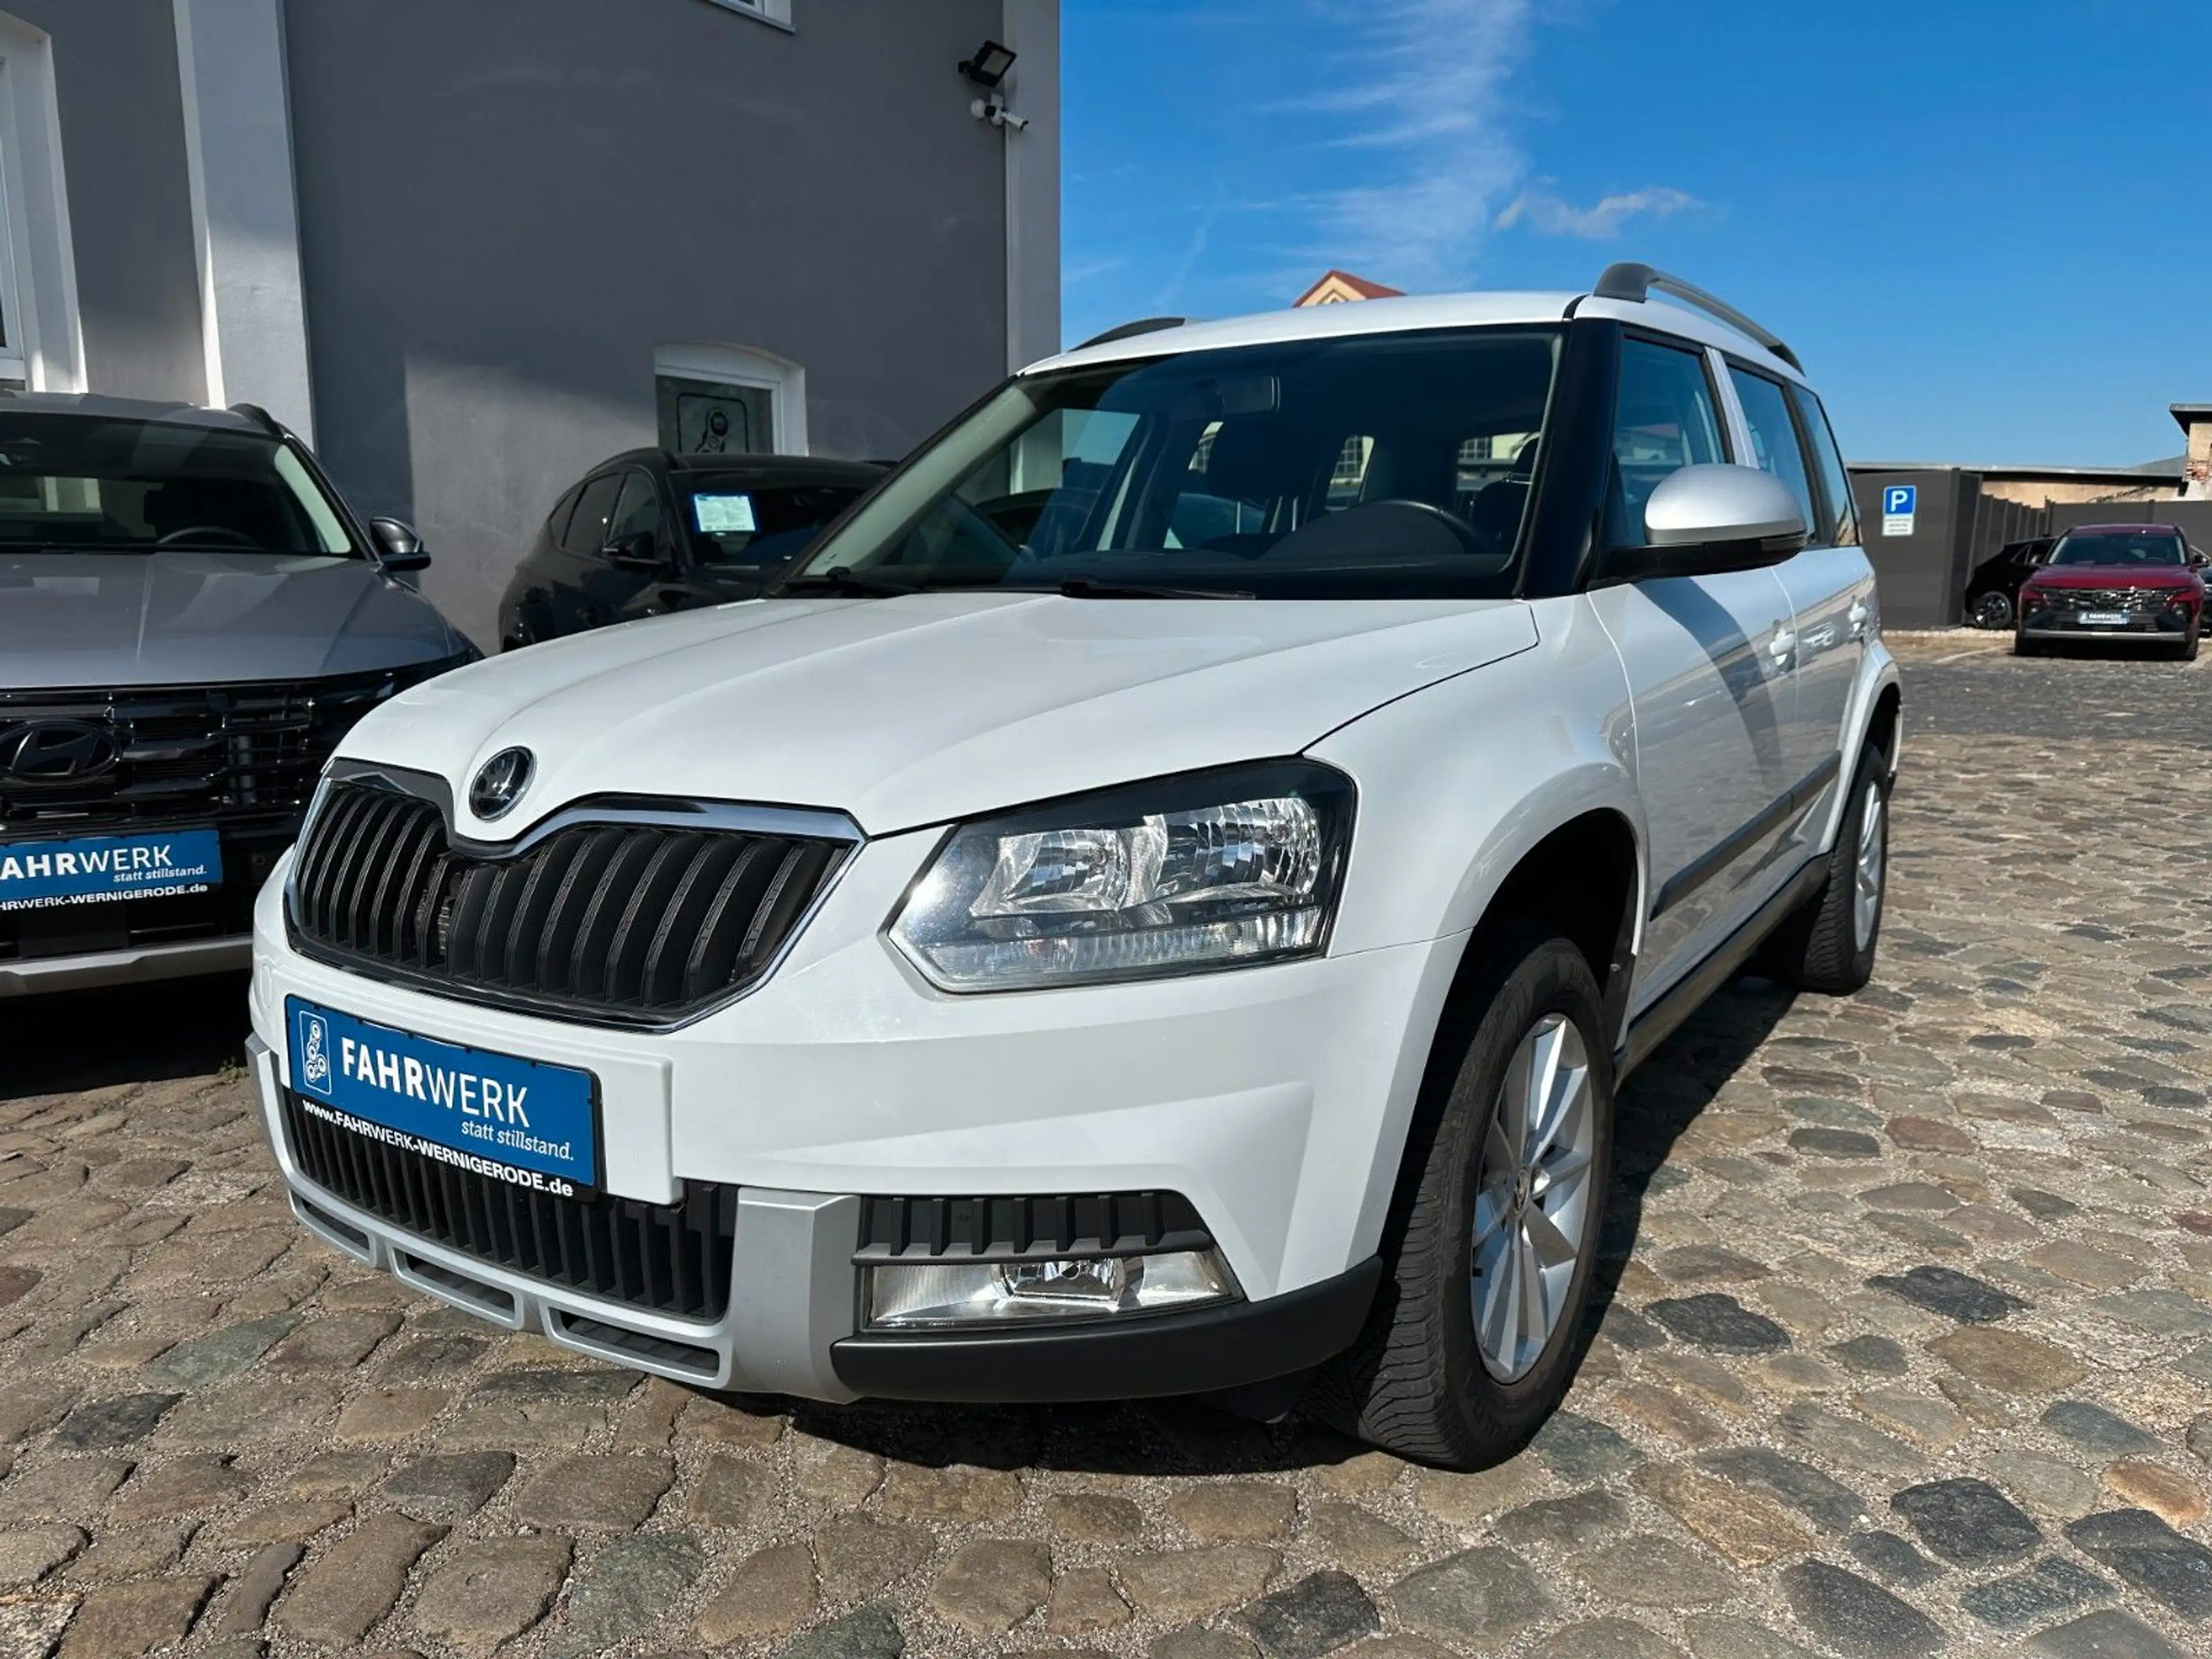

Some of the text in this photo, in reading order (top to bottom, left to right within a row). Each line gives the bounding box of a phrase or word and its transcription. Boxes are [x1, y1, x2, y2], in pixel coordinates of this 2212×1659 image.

[1891, 490, 1908, 512] P
[113, 864, 207, 882] statt stillstand.
[341, 1037, 531, 1127] FAHRWERK
[302, 1099, 574, 1197] www.FAHRWERK-WERNIGERODE.de
[461, 1120, 574, 1161] statt stillstand.
